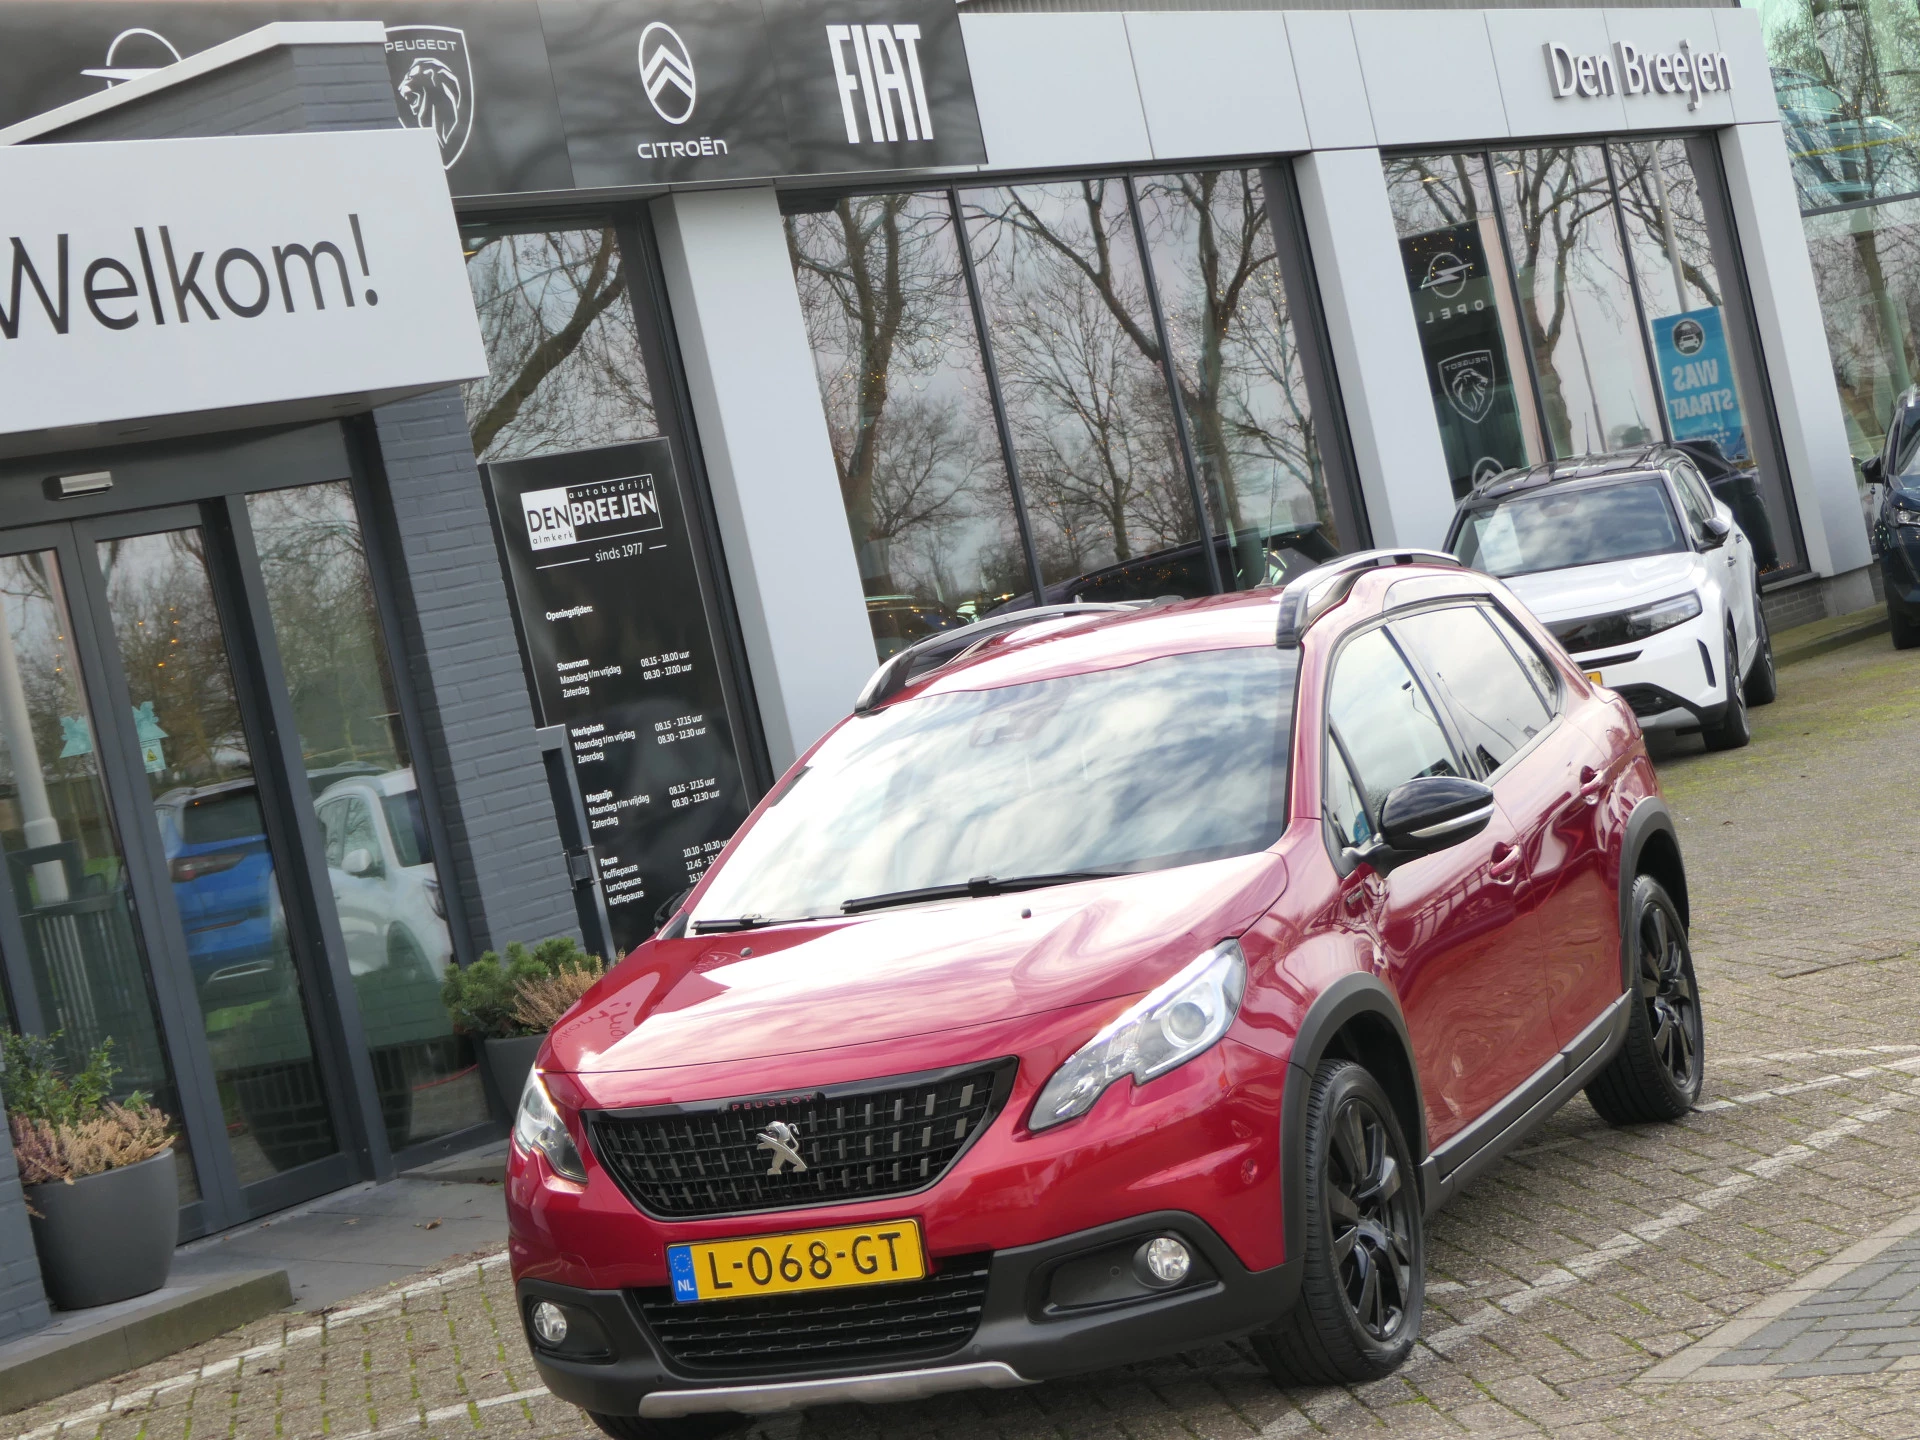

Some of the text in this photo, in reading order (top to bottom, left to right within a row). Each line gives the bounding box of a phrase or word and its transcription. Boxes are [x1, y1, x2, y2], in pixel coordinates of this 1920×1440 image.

[384, 39, 457, 54] PEUGEOT
[825, 24, 934, 144] FIAT
[1541, 38, 1735, 112] Den Breejen
[0, 212, 380, 340] Welkom!
[568, 477, 651, 499] autobedrijf
[526, 490, 657, 533] DEN BREEJEN
[532, 532, 574, 545] almkerk
[595, 542, 643, 562] sinds 1977
[556, 659, 589, 671] Showroom
[560, 672, 588, 684] Maandag
[600, 665, 621, 677] vrijdag
[679, 651, 690, 659] uur
[562, 686, 590, 698] Zaterdag
[681, 664, 692, 672] uur
[571, 723, 604, 737] Werkplaats
[574, 738, 602, 751] Maandag
[615, 730, 636, 742] vrijdag
[692, 714, 703, 723] uur
[577, 751, 604, 764] Zaterdag
[695, 727, 706, 735] uur
[585, 789, 613, 803] Magazijn
[588, 803, 617, 816] Maandag
[628, 794, 650, 806] vrijdag
[705, 778, 715, 786] uur
[591, 816, 619, 829] Zaterdag
[709, 790, 720, 798] uur
[600, 856, 618, 867] Pauze
[606, 877, 642, 893] Lunchpauze
[732, 1094, 812, 1112] PEUGEOT
[677, 1231, 901, 1292] NL L-068-GT
